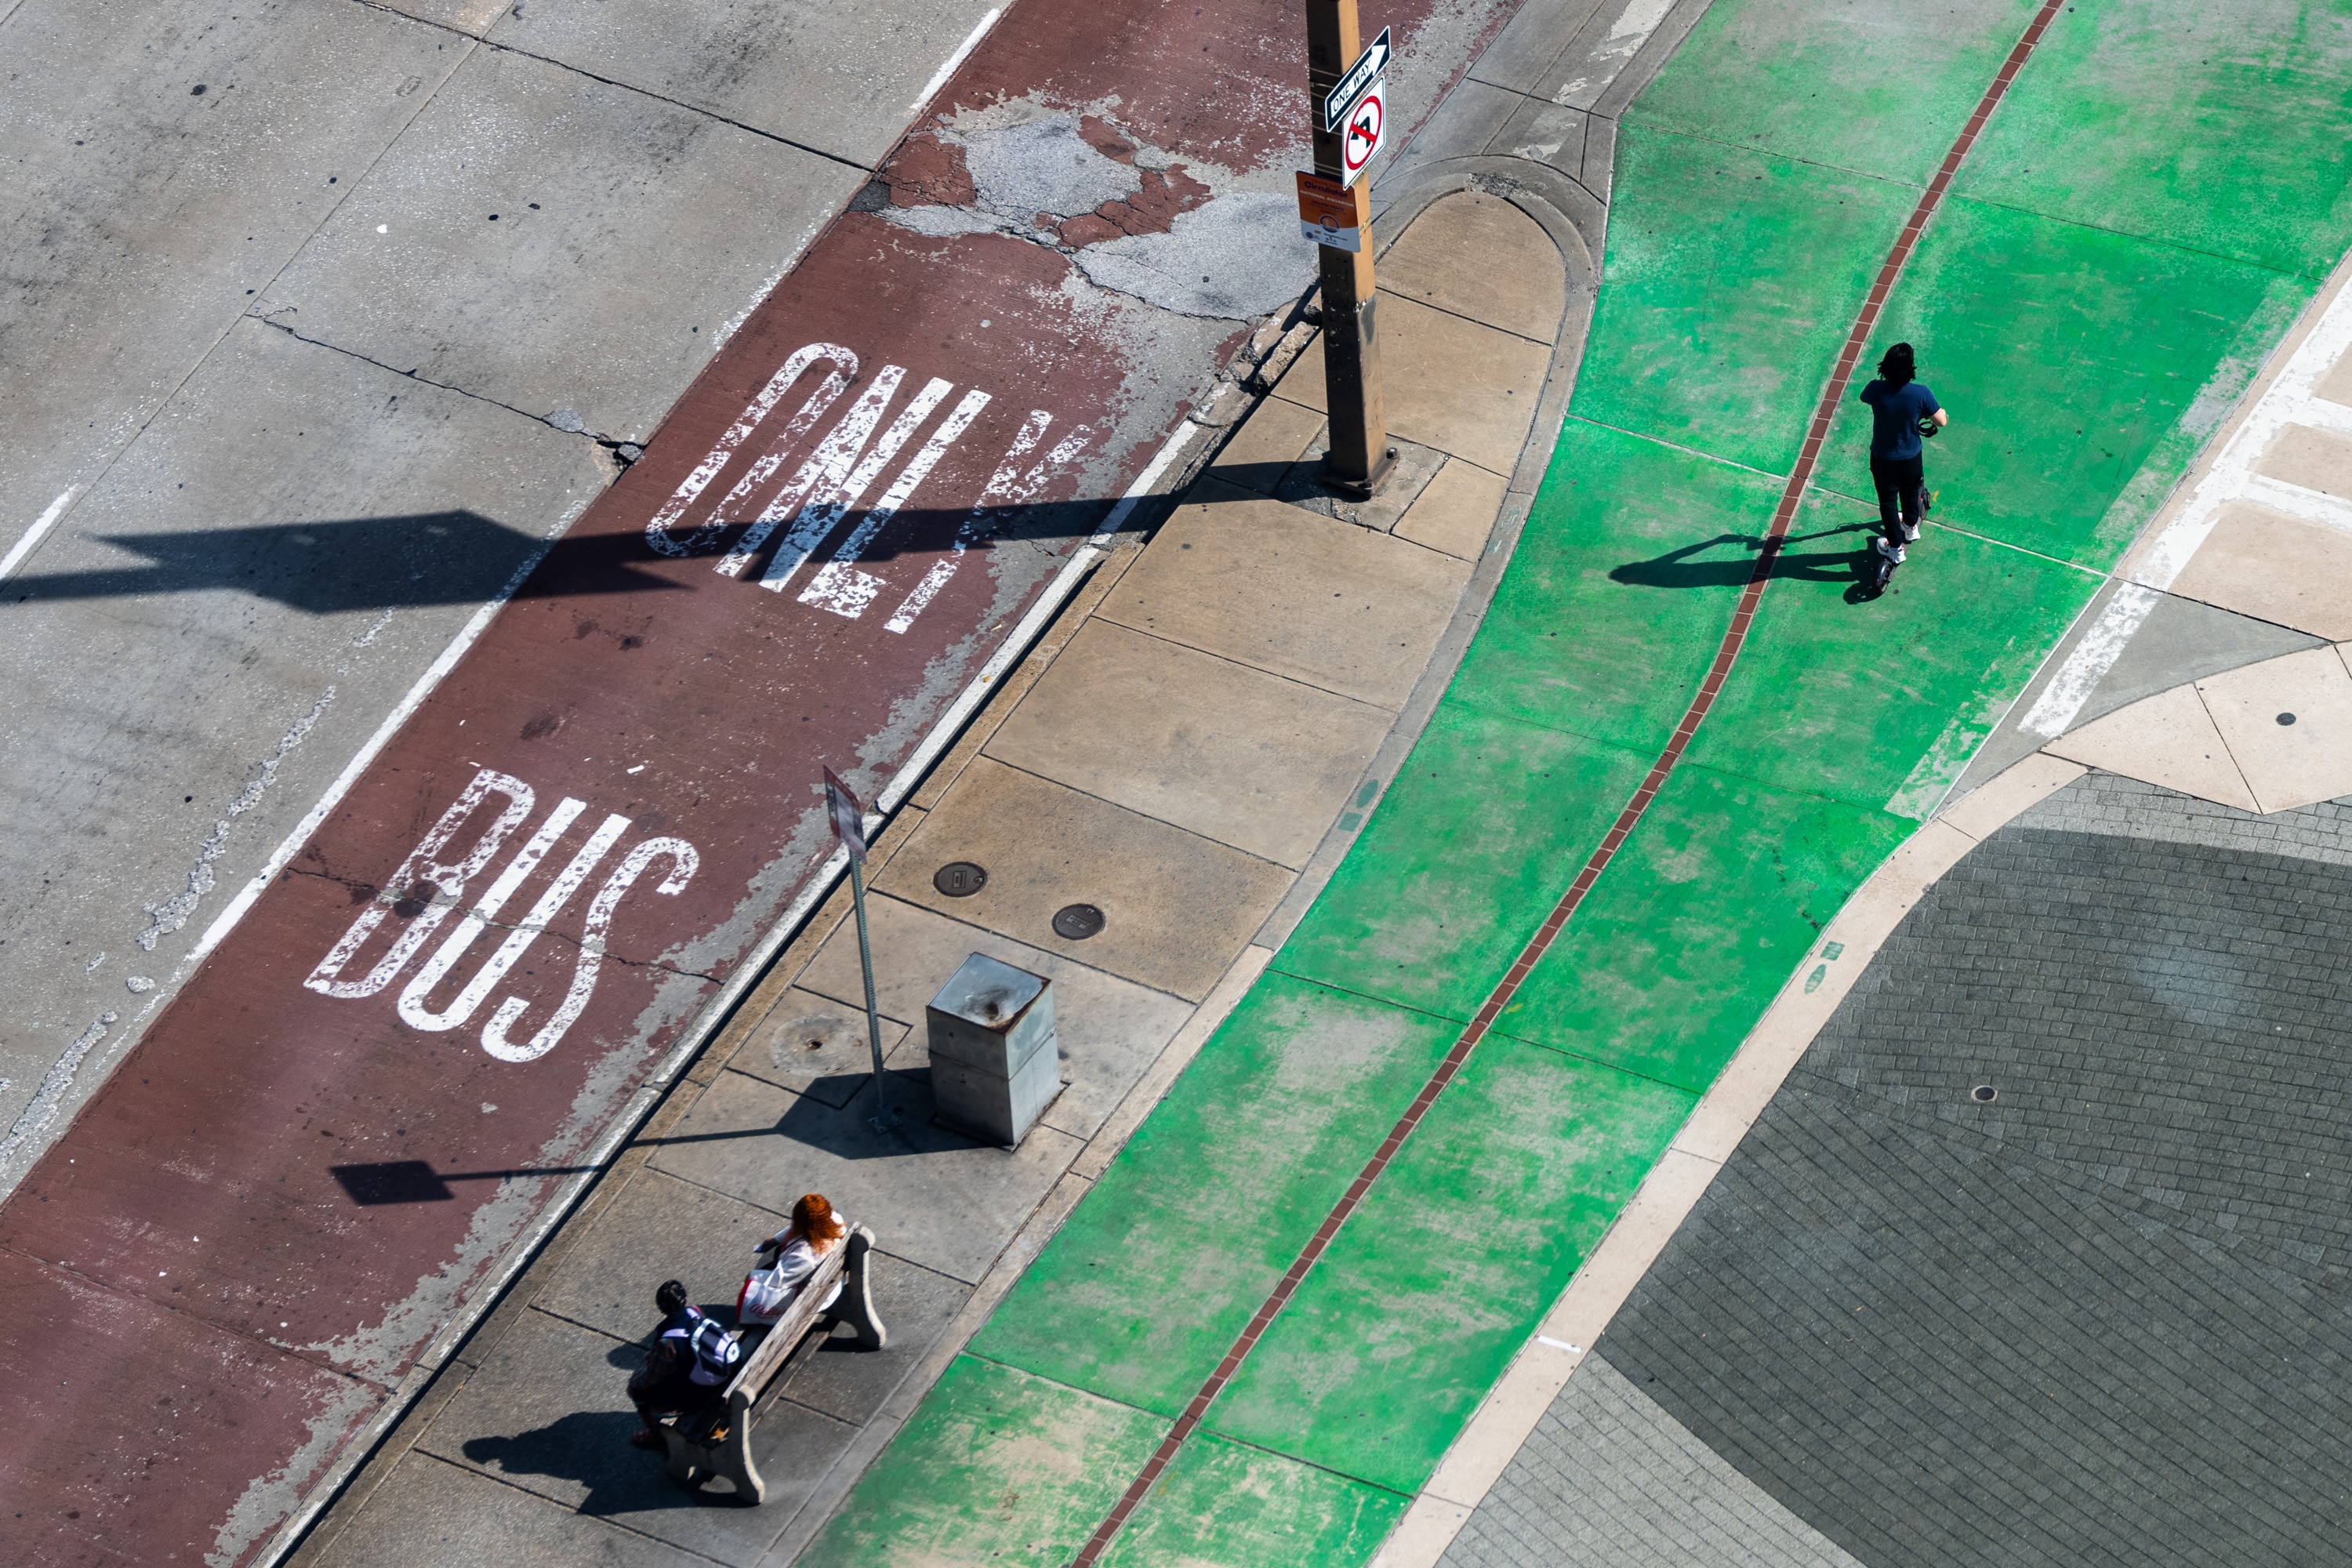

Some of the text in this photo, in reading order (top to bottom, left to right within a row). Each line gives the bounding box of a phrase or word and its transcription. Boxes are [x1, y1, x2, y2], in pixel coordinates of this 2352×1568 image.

[1333, 60, 1370, 112] ONE WAY
[1299, 190, 1355, 207] NATIONAL AQUARIUM
[1304, 180, 1348, 198] Circulator
[644, 342, 1097, 635] ONLY
[303, 768, 700, 1063] BUS
